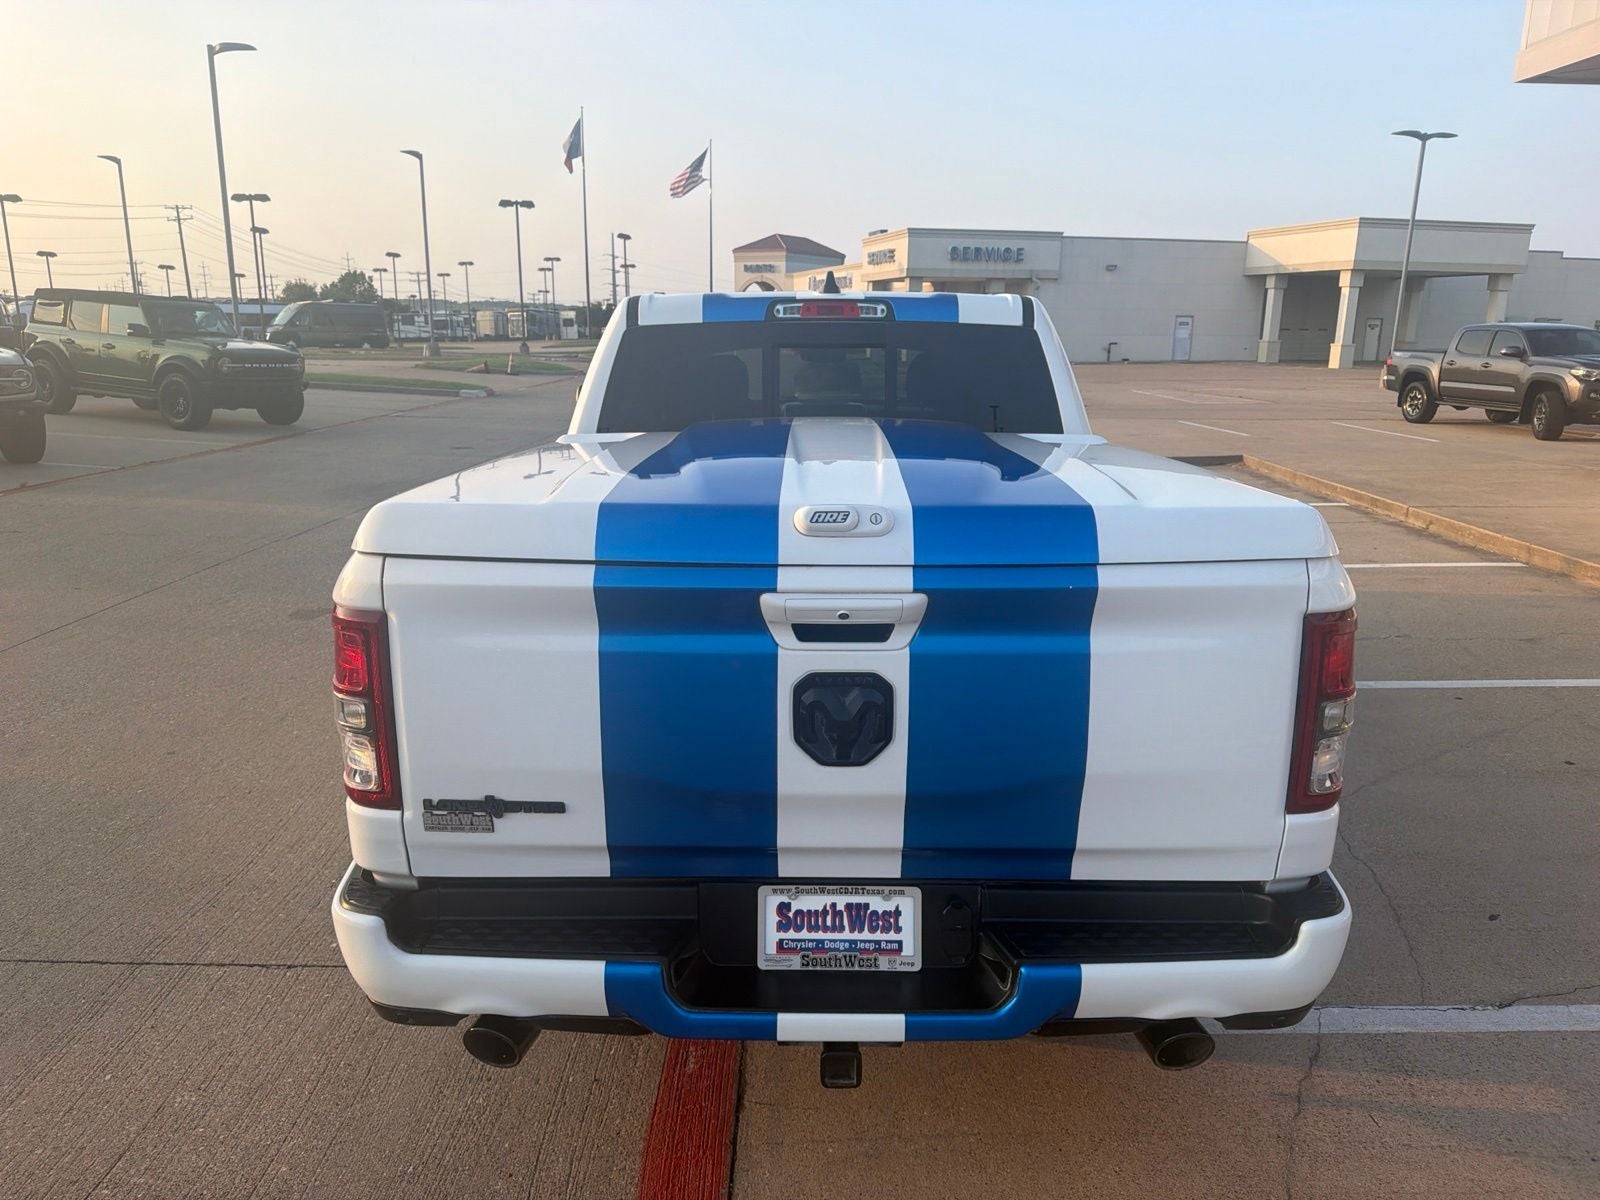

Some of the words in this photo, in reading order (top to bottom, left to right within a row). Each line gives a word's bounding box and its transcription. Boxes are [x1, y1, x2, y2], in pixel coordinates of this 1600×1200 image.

[949, 246, 1025, 263] SERVICE
[809, 510, 850, 523] ARE
[776, 901, 903, 934] SouthWest
[783, 940, 817, 950] Chrysler
[824, 940, 849, 949] Dodge
[856, 941, 875, 950] Jeep
[881, 941, 899, 949] Ram
[801, 953, 880, 969] SouthWest
[899, 960, 915, 968] Jeep
